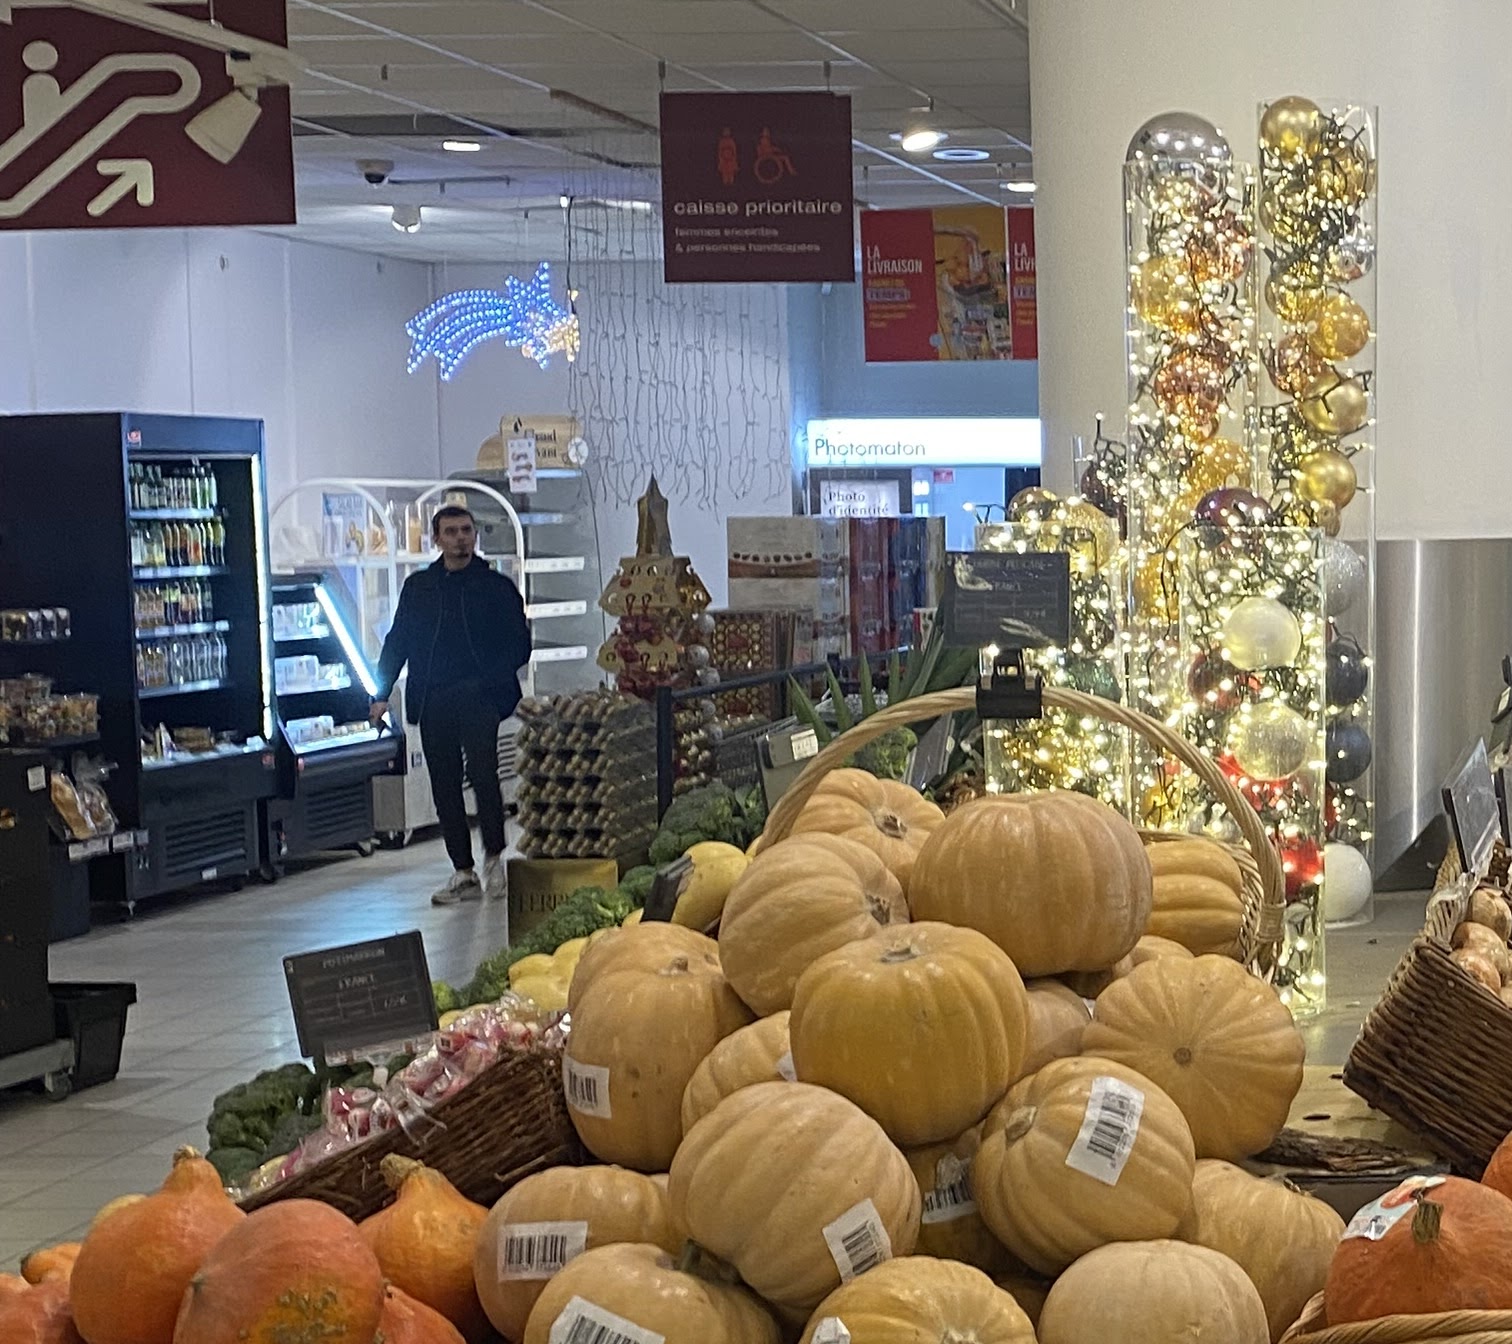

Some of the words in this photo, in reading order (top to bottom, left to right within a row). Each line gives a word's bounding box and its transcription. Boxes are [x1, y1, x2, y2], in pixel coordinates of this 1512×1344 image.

[674, 199, 738, 215] caisse
[745, 199, 842, 217] prioritaire
[867, 245, 880, 259] LA
[1014, 242, 1028, 256] LA
[867, 259, 922, 274] LIVRAISON
[815, 438, 926, 456] Photomaton
[828, 491, 865, 502] Photo
